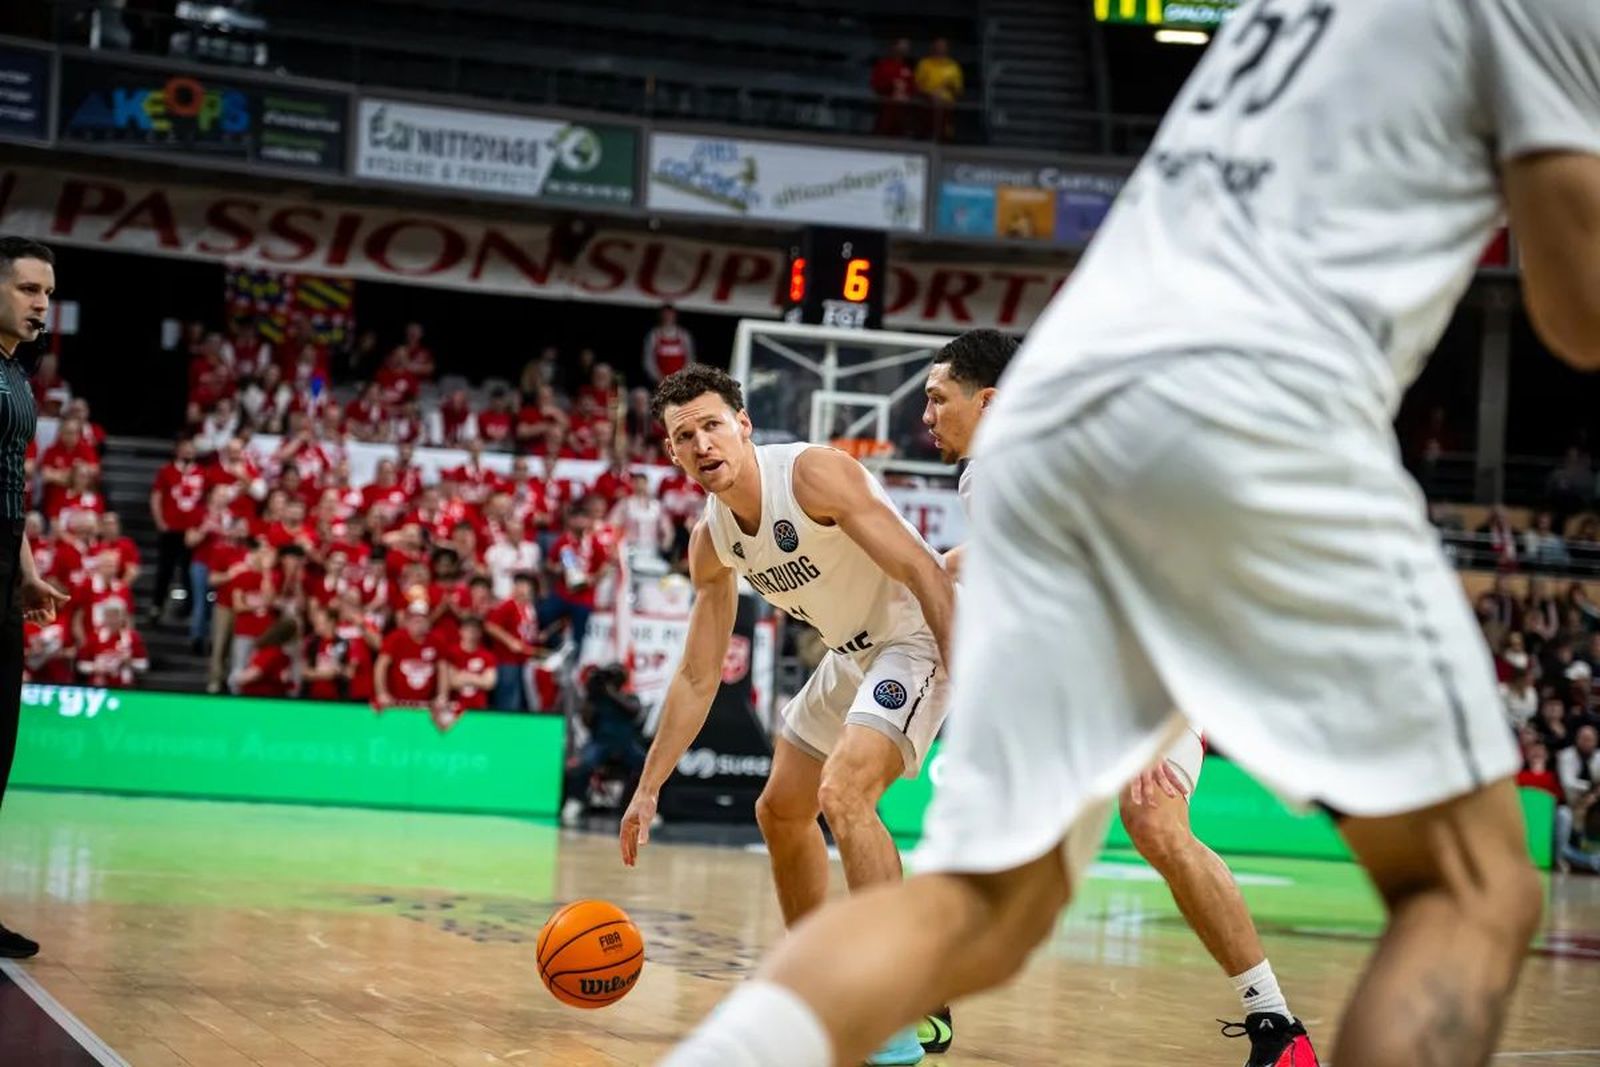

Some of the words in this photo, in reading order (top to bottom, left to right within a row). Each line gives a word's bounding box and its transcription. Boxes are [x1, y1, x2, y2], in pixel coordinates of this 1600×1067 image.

[51, 179, 562, 286] PASSION
[843, 257, 871, 303] 6
[22, 684, 120, 718] ergy.
[26, 724, 84, 760] ing
[599, 931, 622, 948] FIBA
